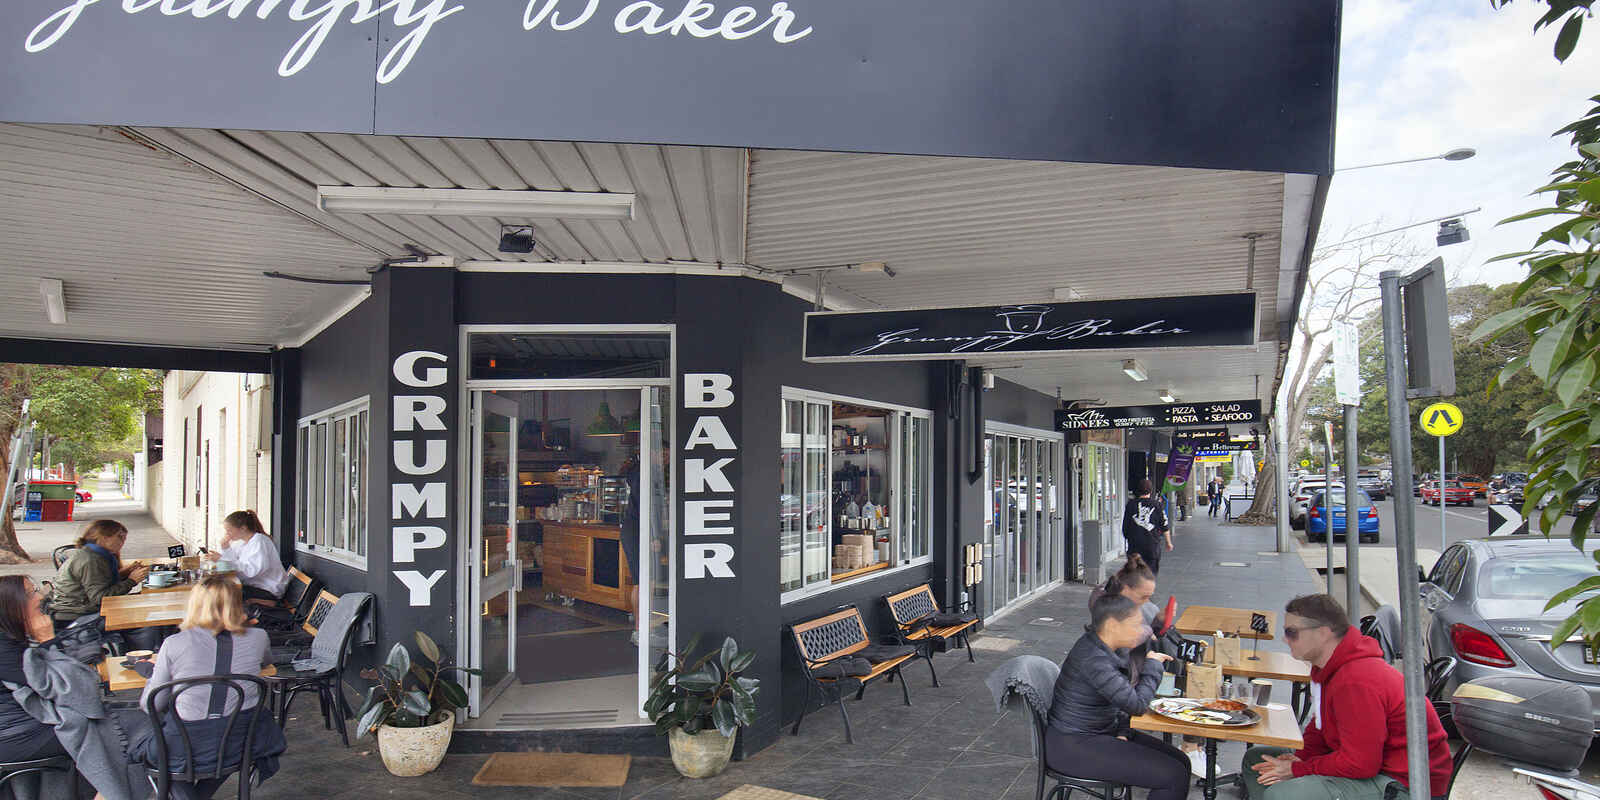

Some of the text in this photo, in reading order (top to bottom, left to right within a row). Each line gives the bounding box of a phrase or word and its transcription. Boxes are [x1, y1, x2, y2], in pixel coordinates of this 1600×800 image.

[850, 319, 1191, 355] Grumpy Baker
[1172, 404, 1240, 415] PIZZA SALAD
[1172, 412, 1253, 423] PASTA SEAFOOD
[392, 351, 448, 606] GRUMPY
[684, 373, 737, 579] BAKER
[170, 546, 183, 557] 25
[1180, 642, 1197, 660] 14
